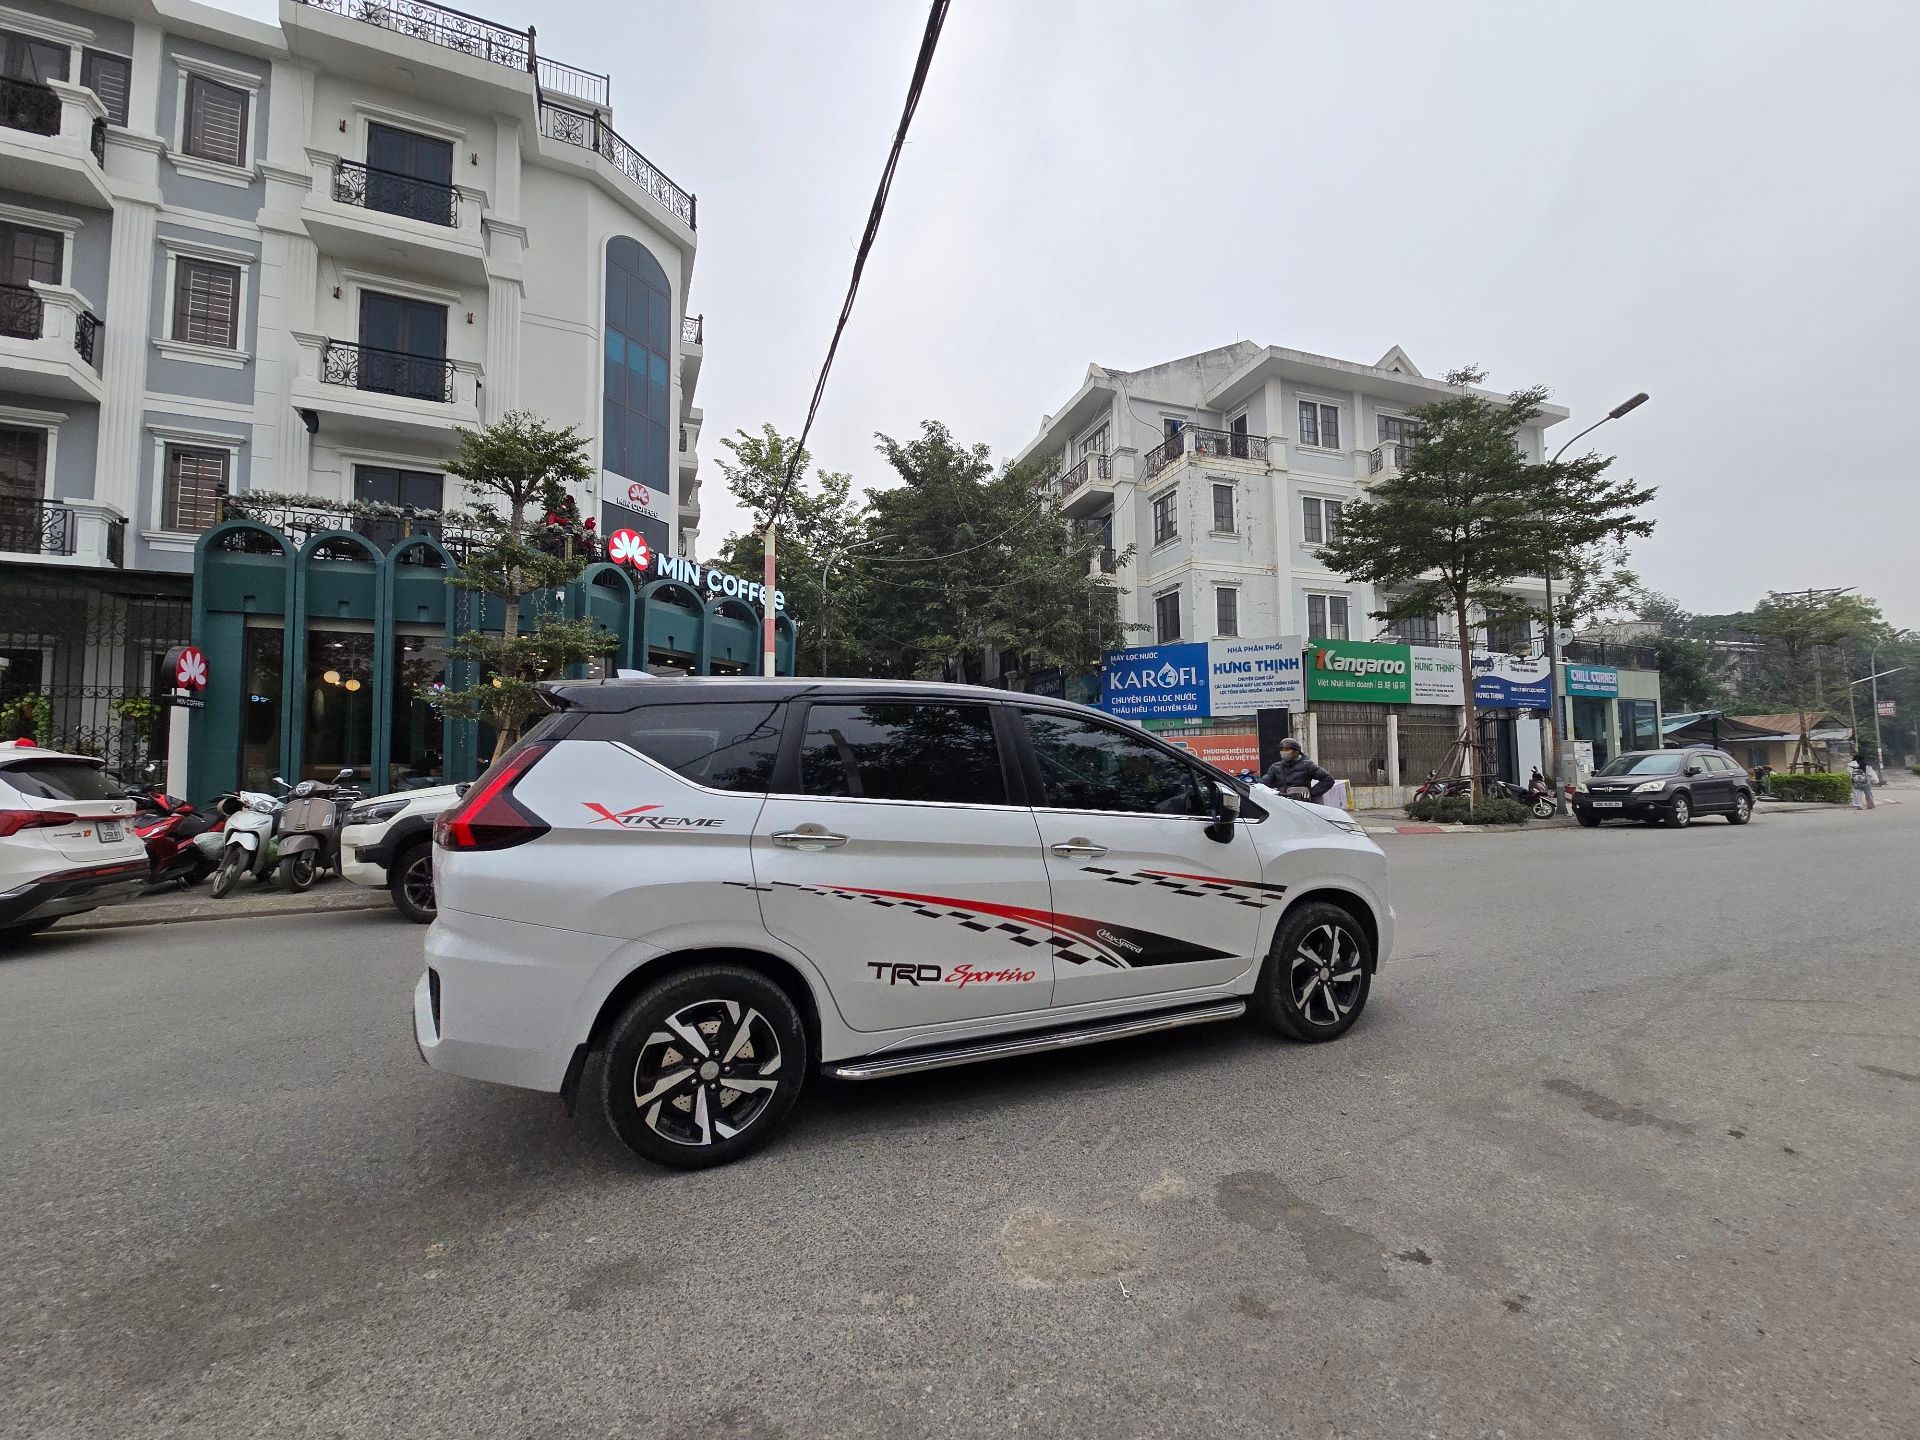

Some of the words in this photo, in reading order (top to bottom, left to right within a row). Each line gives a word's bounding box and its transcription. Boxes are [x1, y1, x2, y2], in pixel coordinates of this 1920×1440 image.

[617, 497, 632, 508] MIN
[657, 552, 700, 587] MIN
[1227, 646, 1242, 654] NHÀ
[1244, 645, 1263, 653] PHÂN
[1265, 642, 1282, 651] PHỐI
[1110, 653, 1125, 662] MÁY
[1126, 653, 1138, 662] LỌC
[1139, 651, 1158, 660] NƯỚC
[1213, 661, 1252, 675] HƯNG
[1255, 658, 1299, 674] THỊNH
[1414, 662, 1433, 671] HƯNG
[1435, 664, 1455, 674] THỊNH
[1110, 662, 1197, 690] KAROFI
[1570, 670, 1590, 682] CHILL
[1590, 671, 1617, 684] CORNER
[1317, 679, 1329, 687] Việt
[1330, 680, 1344, 688] Nhật
[1345, 680, 1355, 688] liên
[1356, 681, 1373, 689] doanh
[1111, 696, 1142, 705] CHUYÊN
[1143, 695, 1156, 703] GIA
[1158, 694, 1172, 704] LỌC
[1174, 692, 1197, 701] NƯỚC
[1153, 703, 1181, 713] CHUYÊN
[1182, 703, 1197, 711] SÂU
[1229, 747, 1244, 755] HIỆU
[581, 802, 725, 831] XTREME
[1097, 929, 1143, 953] MaxSpeed
[867, 961, 942, 986] TRD
[944, 964, 1035, 989] Sportivo
